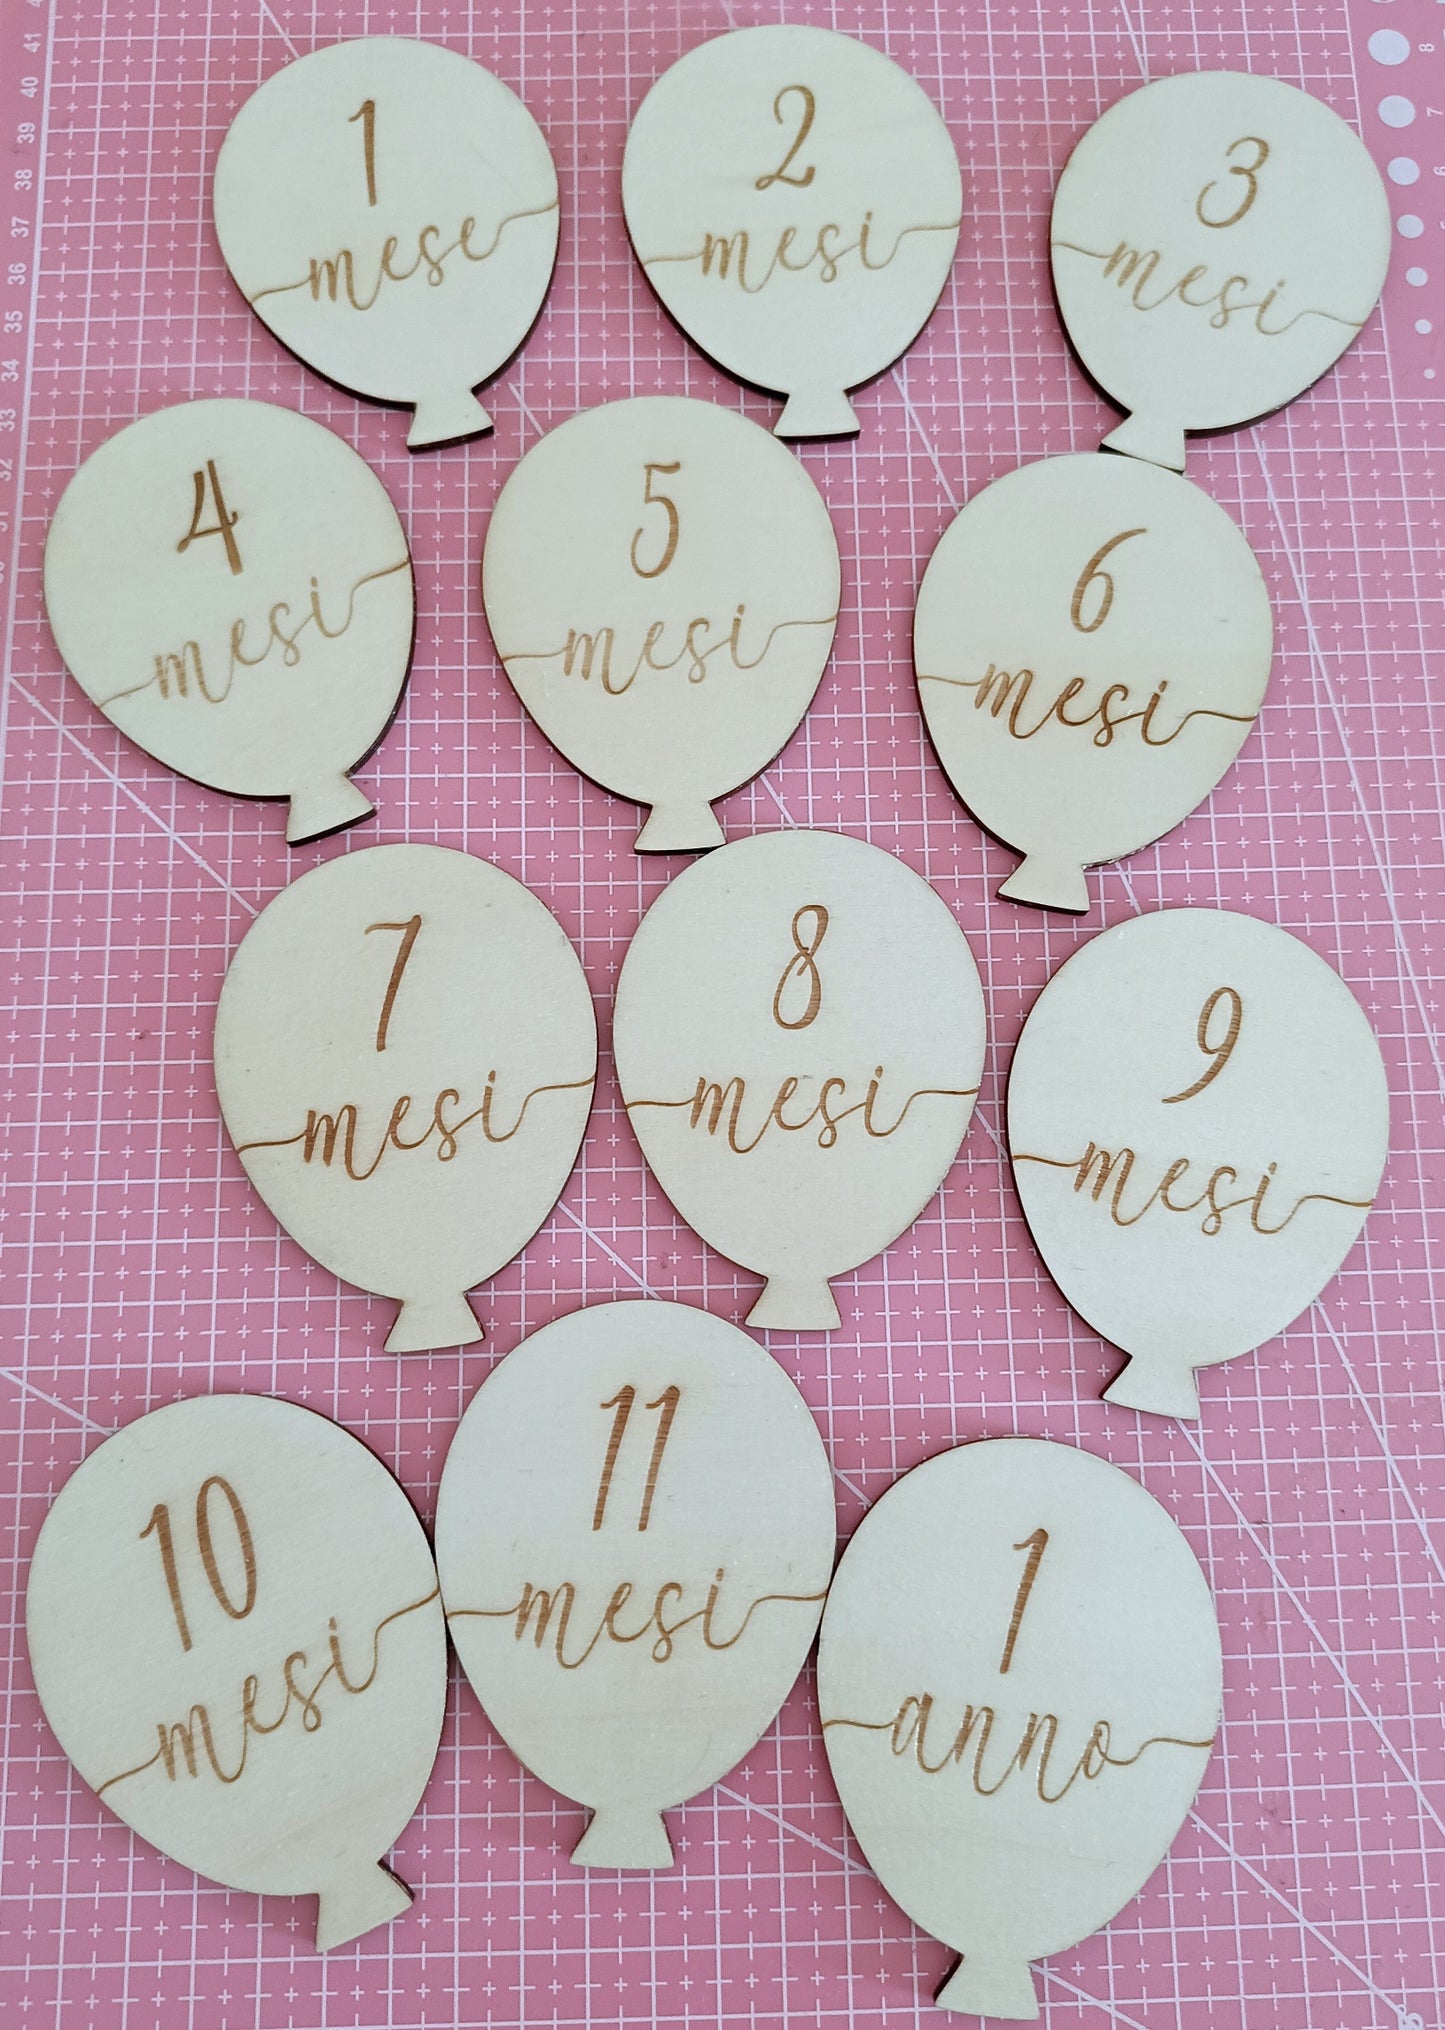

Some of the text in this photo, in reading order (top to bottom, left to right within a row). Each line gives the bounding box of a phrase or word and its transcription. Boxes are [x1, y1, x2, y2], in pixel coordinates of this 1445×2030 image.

[20, 76, 39, 98] 40
[23, 33, 42, 53] 41
[1418, 43, 1435, 52] 8
[17, 122, 36, 144] 39
[348, 98, 377, 207] 1
[754, 84, 816, 191] 2
[1425, 106, 1444, 117] 7
[11, 216, 30, 238] 37
[14, 168, 33, 191] 38
[1196, 136, 1270, 229] 3
[7, 262, 27, 285] 36
[308, 215, 500, 311] mese
[699, 211, 896, 292] mesi
[1100, 241, 1297, 335] mesi
[4, 310, 23, 333] 35
[1, 359, 20, 382] 34
[175, 458, 244, 576] 4
[630, 461, 682, 579] 5
[1070, 528, 1148, 633] 6
[154, 577, 352, 704] mesi
[564, 603, 766, 695] mesi
[973, 664, 1188, 747] mesi
[364, 914, 424, 1052] 7
[773, 905, 829, 1030] 8
[1161, 987, 1244, 1104] 9
[300, 1070, 520, 1181] mesi
[686, 1065, 906, 1154] mesi
[1072, 1141, 1301, 1236] mesi
[592, 1384, 682, 1532] 11
[139, 1475, 257, 1653] 10
[999, 1528, 1049, 1675] 1
[512, 1568, 750, 1670] mesi
[157, 1616, 377, 1784] mesi
[885, 1692, 1129, 1804] anno
